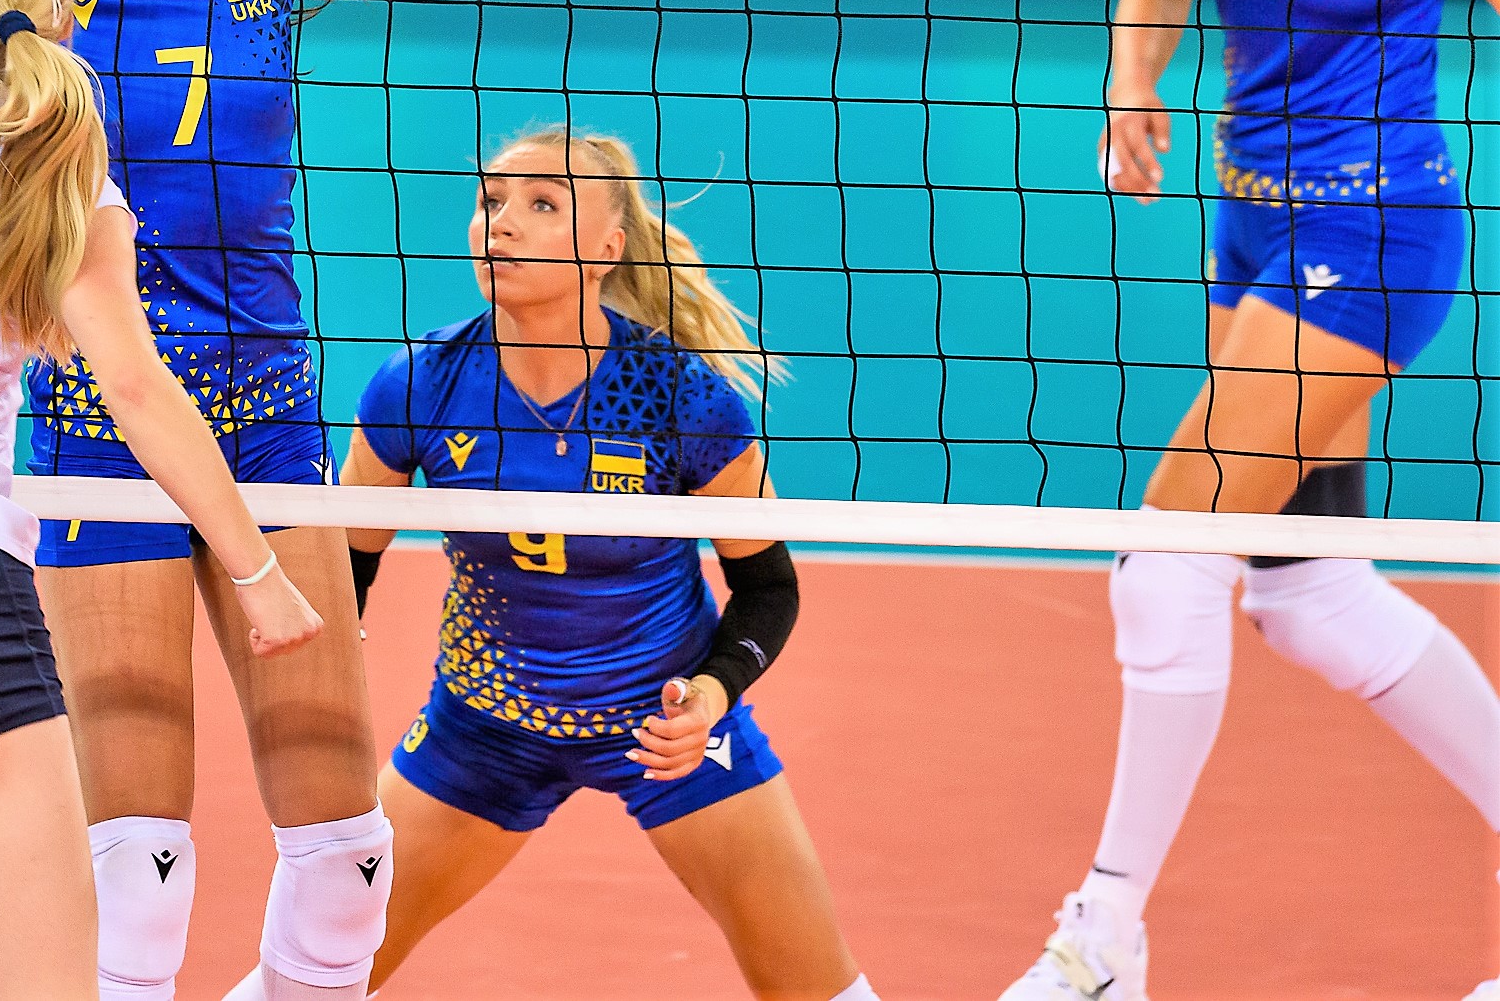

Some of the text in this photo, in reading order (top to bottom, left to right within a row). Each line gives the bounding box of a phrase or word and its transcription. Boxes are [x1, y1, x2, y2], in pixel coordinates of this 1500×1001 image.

[155, 45, 212, 147] 7
[591, 472, 646, 493] UKR
[403, 713, 429, 753] 9
